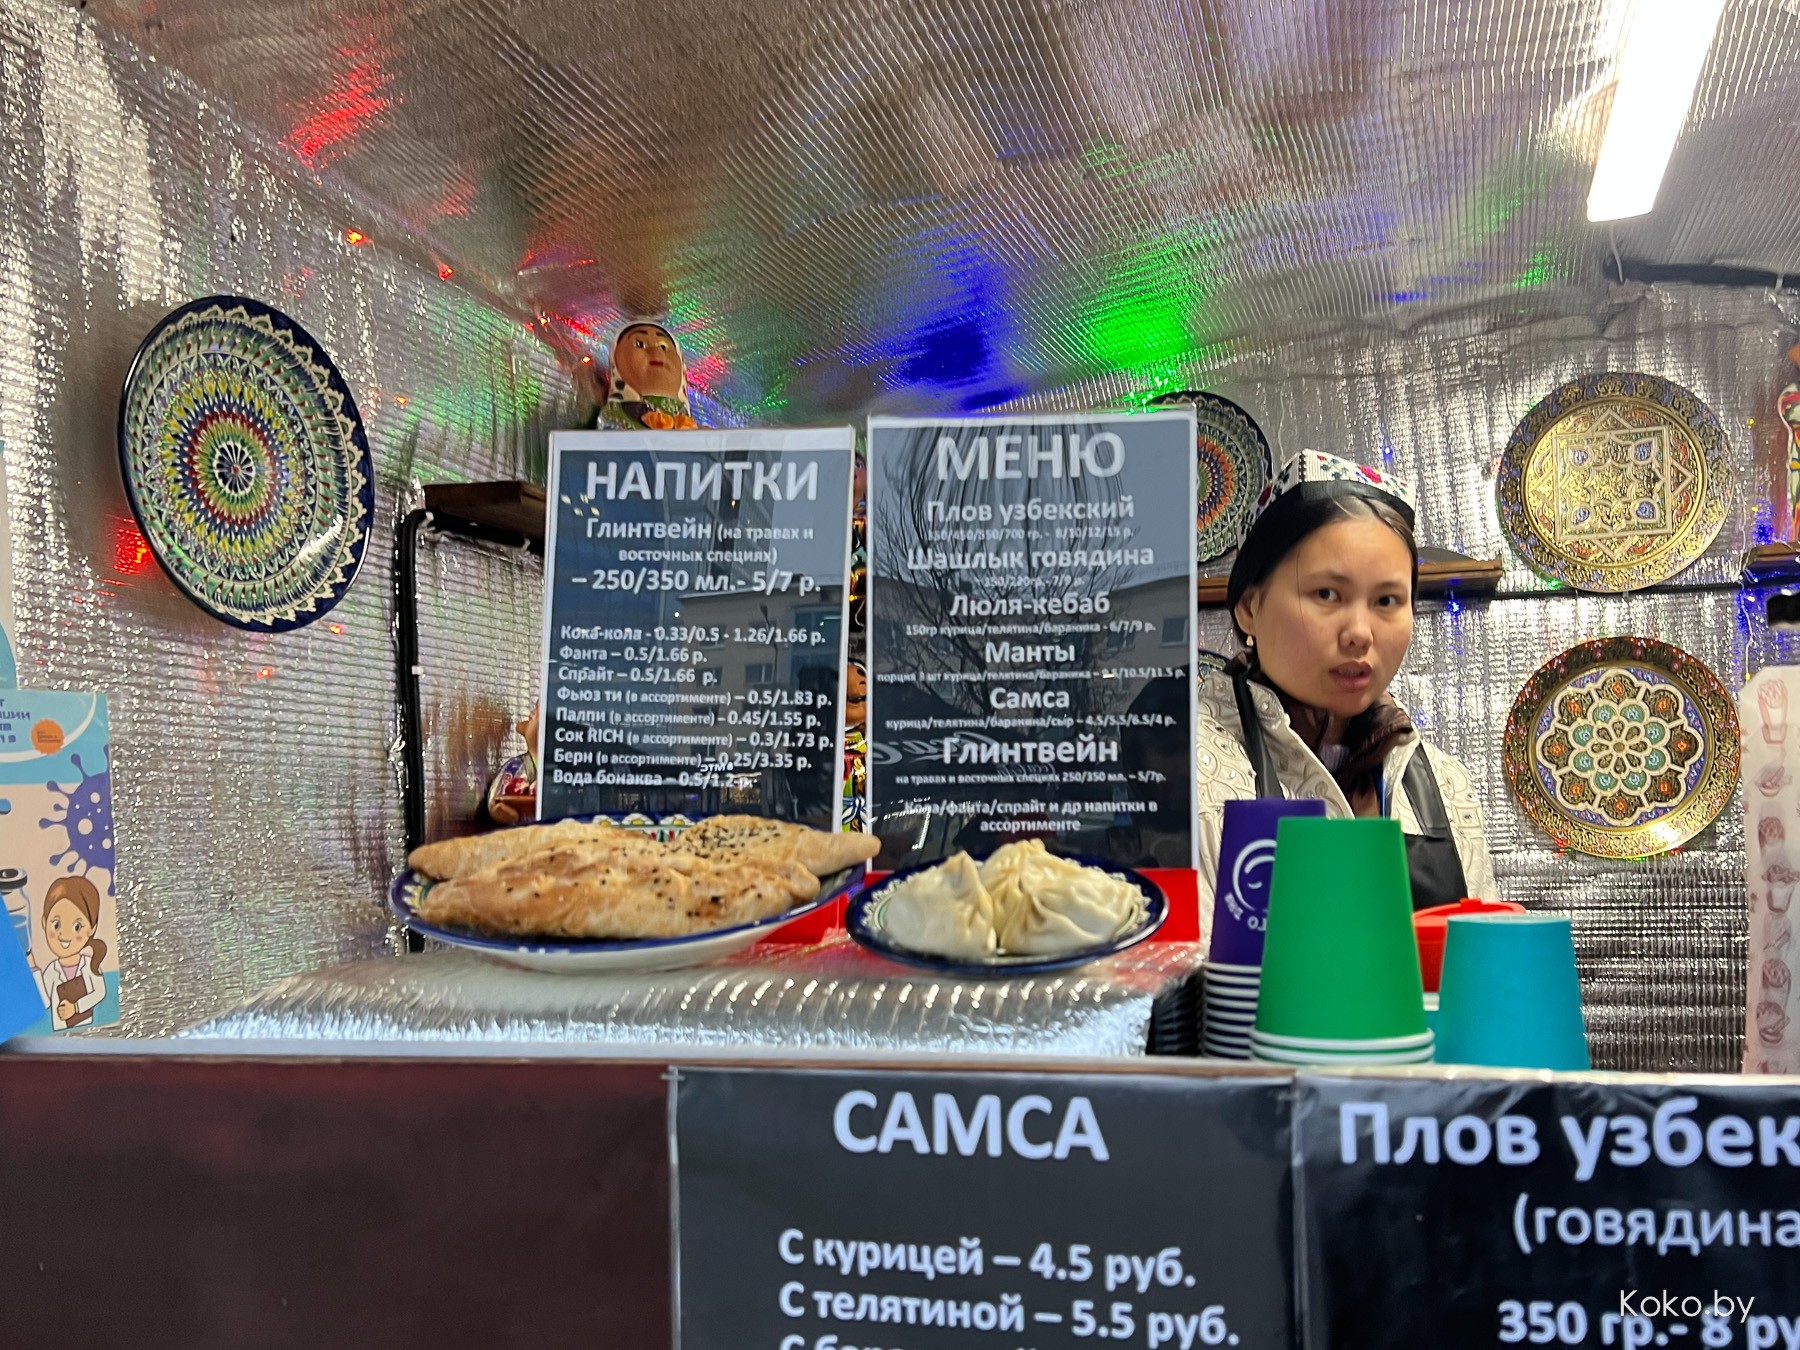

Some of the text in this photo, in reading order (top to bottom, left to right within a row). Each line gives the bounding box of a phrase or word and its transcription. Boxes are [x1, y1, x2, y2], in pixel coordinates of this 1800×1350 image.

[936, 431, 1126, 481] МЕНЮ
[586, 461, 818, 500] НАПИТКИ
[927, 495, 1134, 526] Плов узбекский
[586, 517, 814, 542] Глинтвейн (на травах и
[619, 547, 778, 566] восточных специях)
[906, 547, 1154, 571] Шашлык говядина
[592, 567, 689, 595] 250/350
[752, 568, 793, 597] 5/7
[799, 575, 821, 597] р.
[949, 592, 1110, 617] Люля-кебаб
[561, 625, 642, 640] Кока-кола
[654, 625, 720, 644] 0.33/0.5
[734, 626, 808, 645] 1.26/1.66
[810, 631, 826, 646] р.
[560, 645, 608, 660] Фанта
[624, 645, 689, 664] 0.5/1.66
[692, 651, 707, 665] р.
[985, 641, 1075, 663] Манты
[558, 665, 614, 683] Спрайт
[630, 667, 696, 685] 0.5/1.66
[702, 671, 718, 687] р.
[557, 686, 600, 702] Фьюз
[604, 690, 622, 702] ти
[625, 689, 638, 705] (в
[640, 691, 731, 706] ассортименте)
[747, 689, 813, 708] 0.5/1.83
[816, 694, 832, 709] р.
[990, 687, 1070, 709] Самса
[556, 707, 606, 722] Палпи
[609, 710, 622, 725] (в
[624, 711, 714, 727] ассортименте)
[805, 714, 821, 730] р.
[555, 727, 583, 742] Сок
[587, 728, 624, 743] RICH
[627, 731, 639, 746] (в
[642, 733, 733, 748] ассортименте)
[749, 730, 815, 750] 0.3/1.73
[818, 735, 834, 751] р.
[943, 733, 1118, 764] Глинтвейн
[554, 748, 593, 766] Берн
[596, 751, 608, 766] (в
[610, 753, 702, 768] ассортименте)
[718, 751, 793, 770] 0.25/3.35
[796, 756, 812, 772] р.
[553, 769, 593, 787] Вода
[595, 769, 662, 786] бонаква
[1049, 801, 1058, 812] и
[1062, 801, 1082, 815] др
[1085, 801, 1146, 813] напитки
[1148, 801, 1158, 812] в
[980, 819, 1081, 834] ассортименте
[833, 1090, 1110, 1161] САМСА
[1340, 1101, 1540, 1165] Плов
[1513, 1192, 1800, 1256] (говядина
[778, 1228, 804, 1264] С
[813, 1236, 984, 1281] курицей
[1028, 1242, 1094, 1282] 4.5
[1105, 1246, 1196, 1294] руб.
[778, 1281, 805, 1318] С
[812, 1292, 1025, 1333] телятиной
[1071, 1299, 1135, 1339] 5.5
[1147, 1305, 1240, 1350] руб.
[1498, 1299, 1588, 1345] 350
